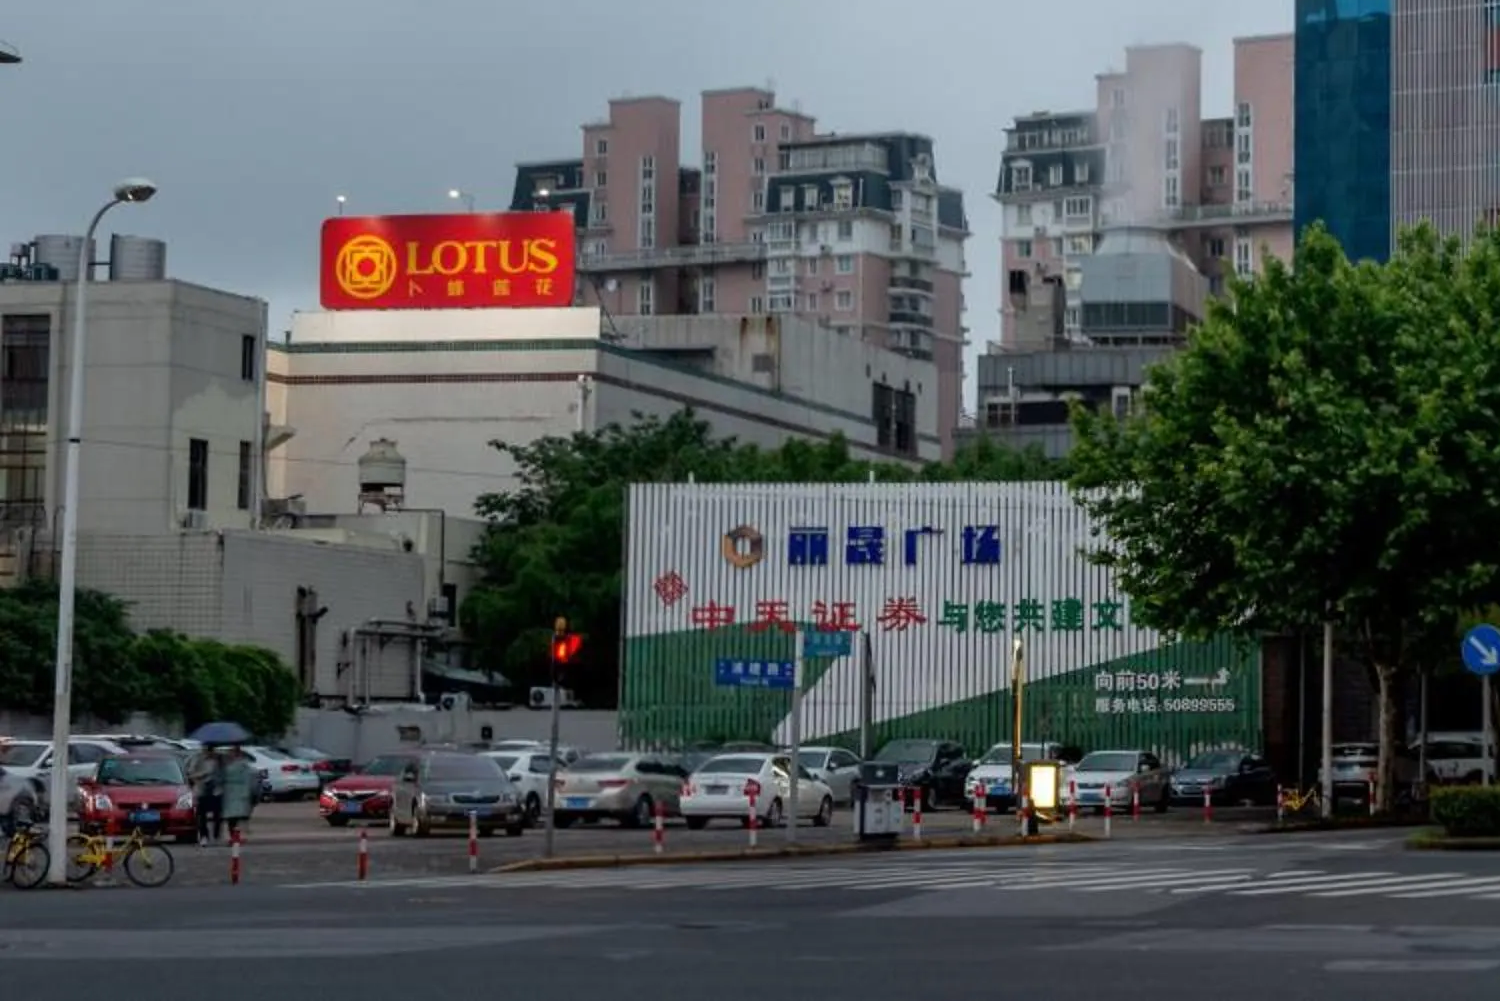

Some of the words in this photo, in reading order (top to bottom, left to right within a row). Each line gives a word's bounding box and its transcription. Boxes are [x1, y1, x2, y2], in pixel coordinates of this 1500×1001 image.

[406, 239, 558, 276] LOTUS
[691, 596, 927, 633] 中天证券
[1095, 669, 1181, 692] 向前50米
